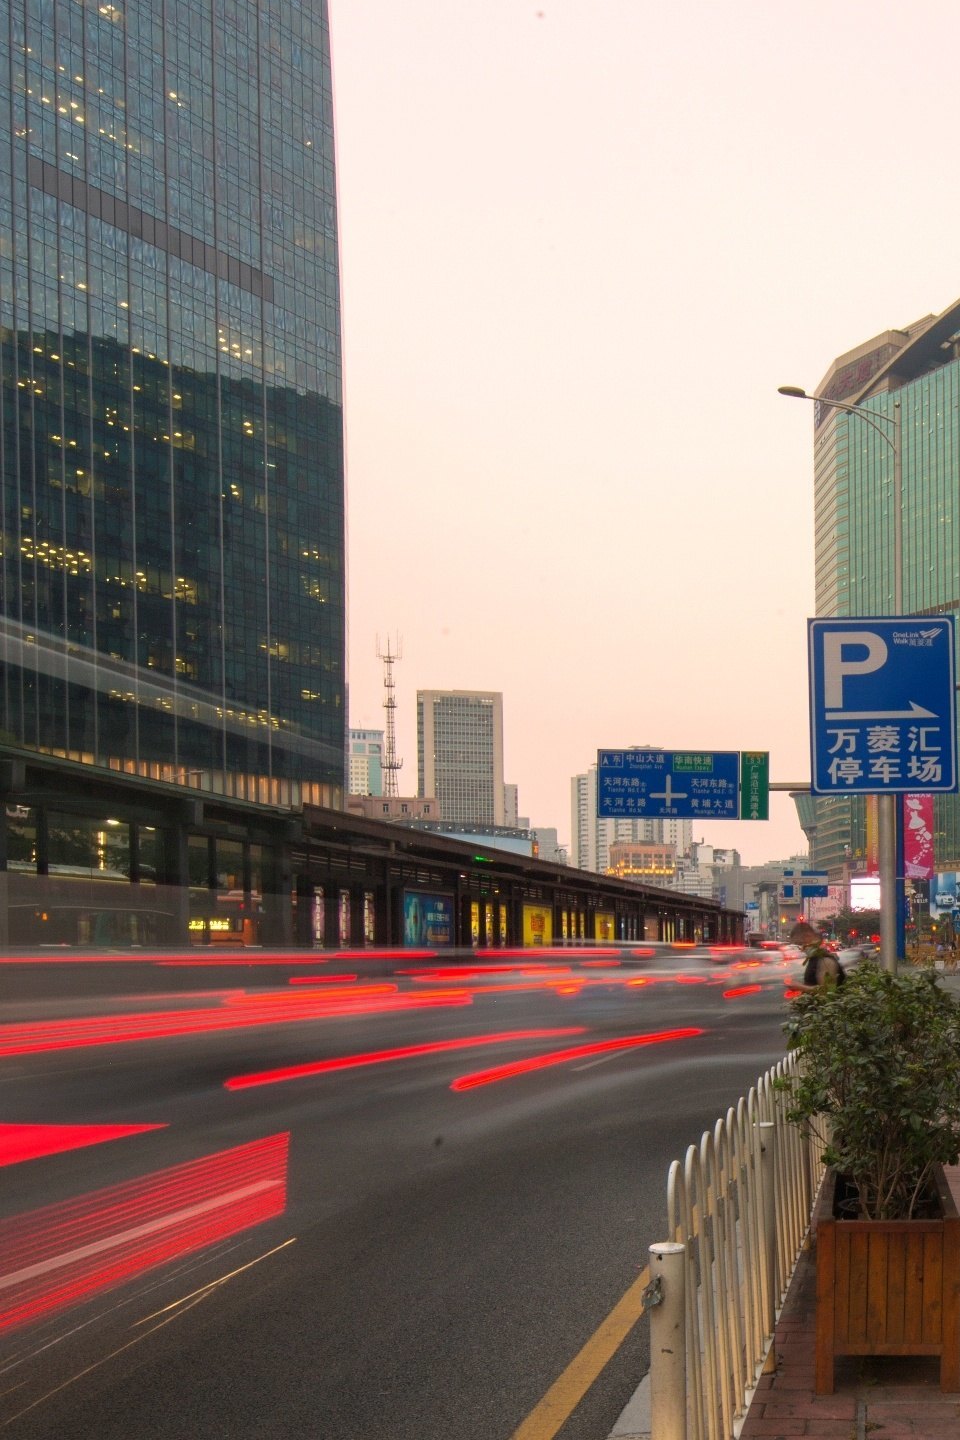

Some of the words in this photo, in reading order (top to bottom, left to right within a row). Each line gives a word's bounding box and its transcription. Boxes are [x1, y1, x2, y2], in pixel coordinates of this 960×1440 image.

[823, 631, 888, 709] P
[826, 725, 942, 754] 万菱汇
[626, 754, 665, 764] 中山大道
[674, 755, 712, 765] 华南快速
[827, 755, 942, 785] 停车场
[603, 797, 646, 807] 天河北路
[691, 799, 734, 809] 黄埔大道
